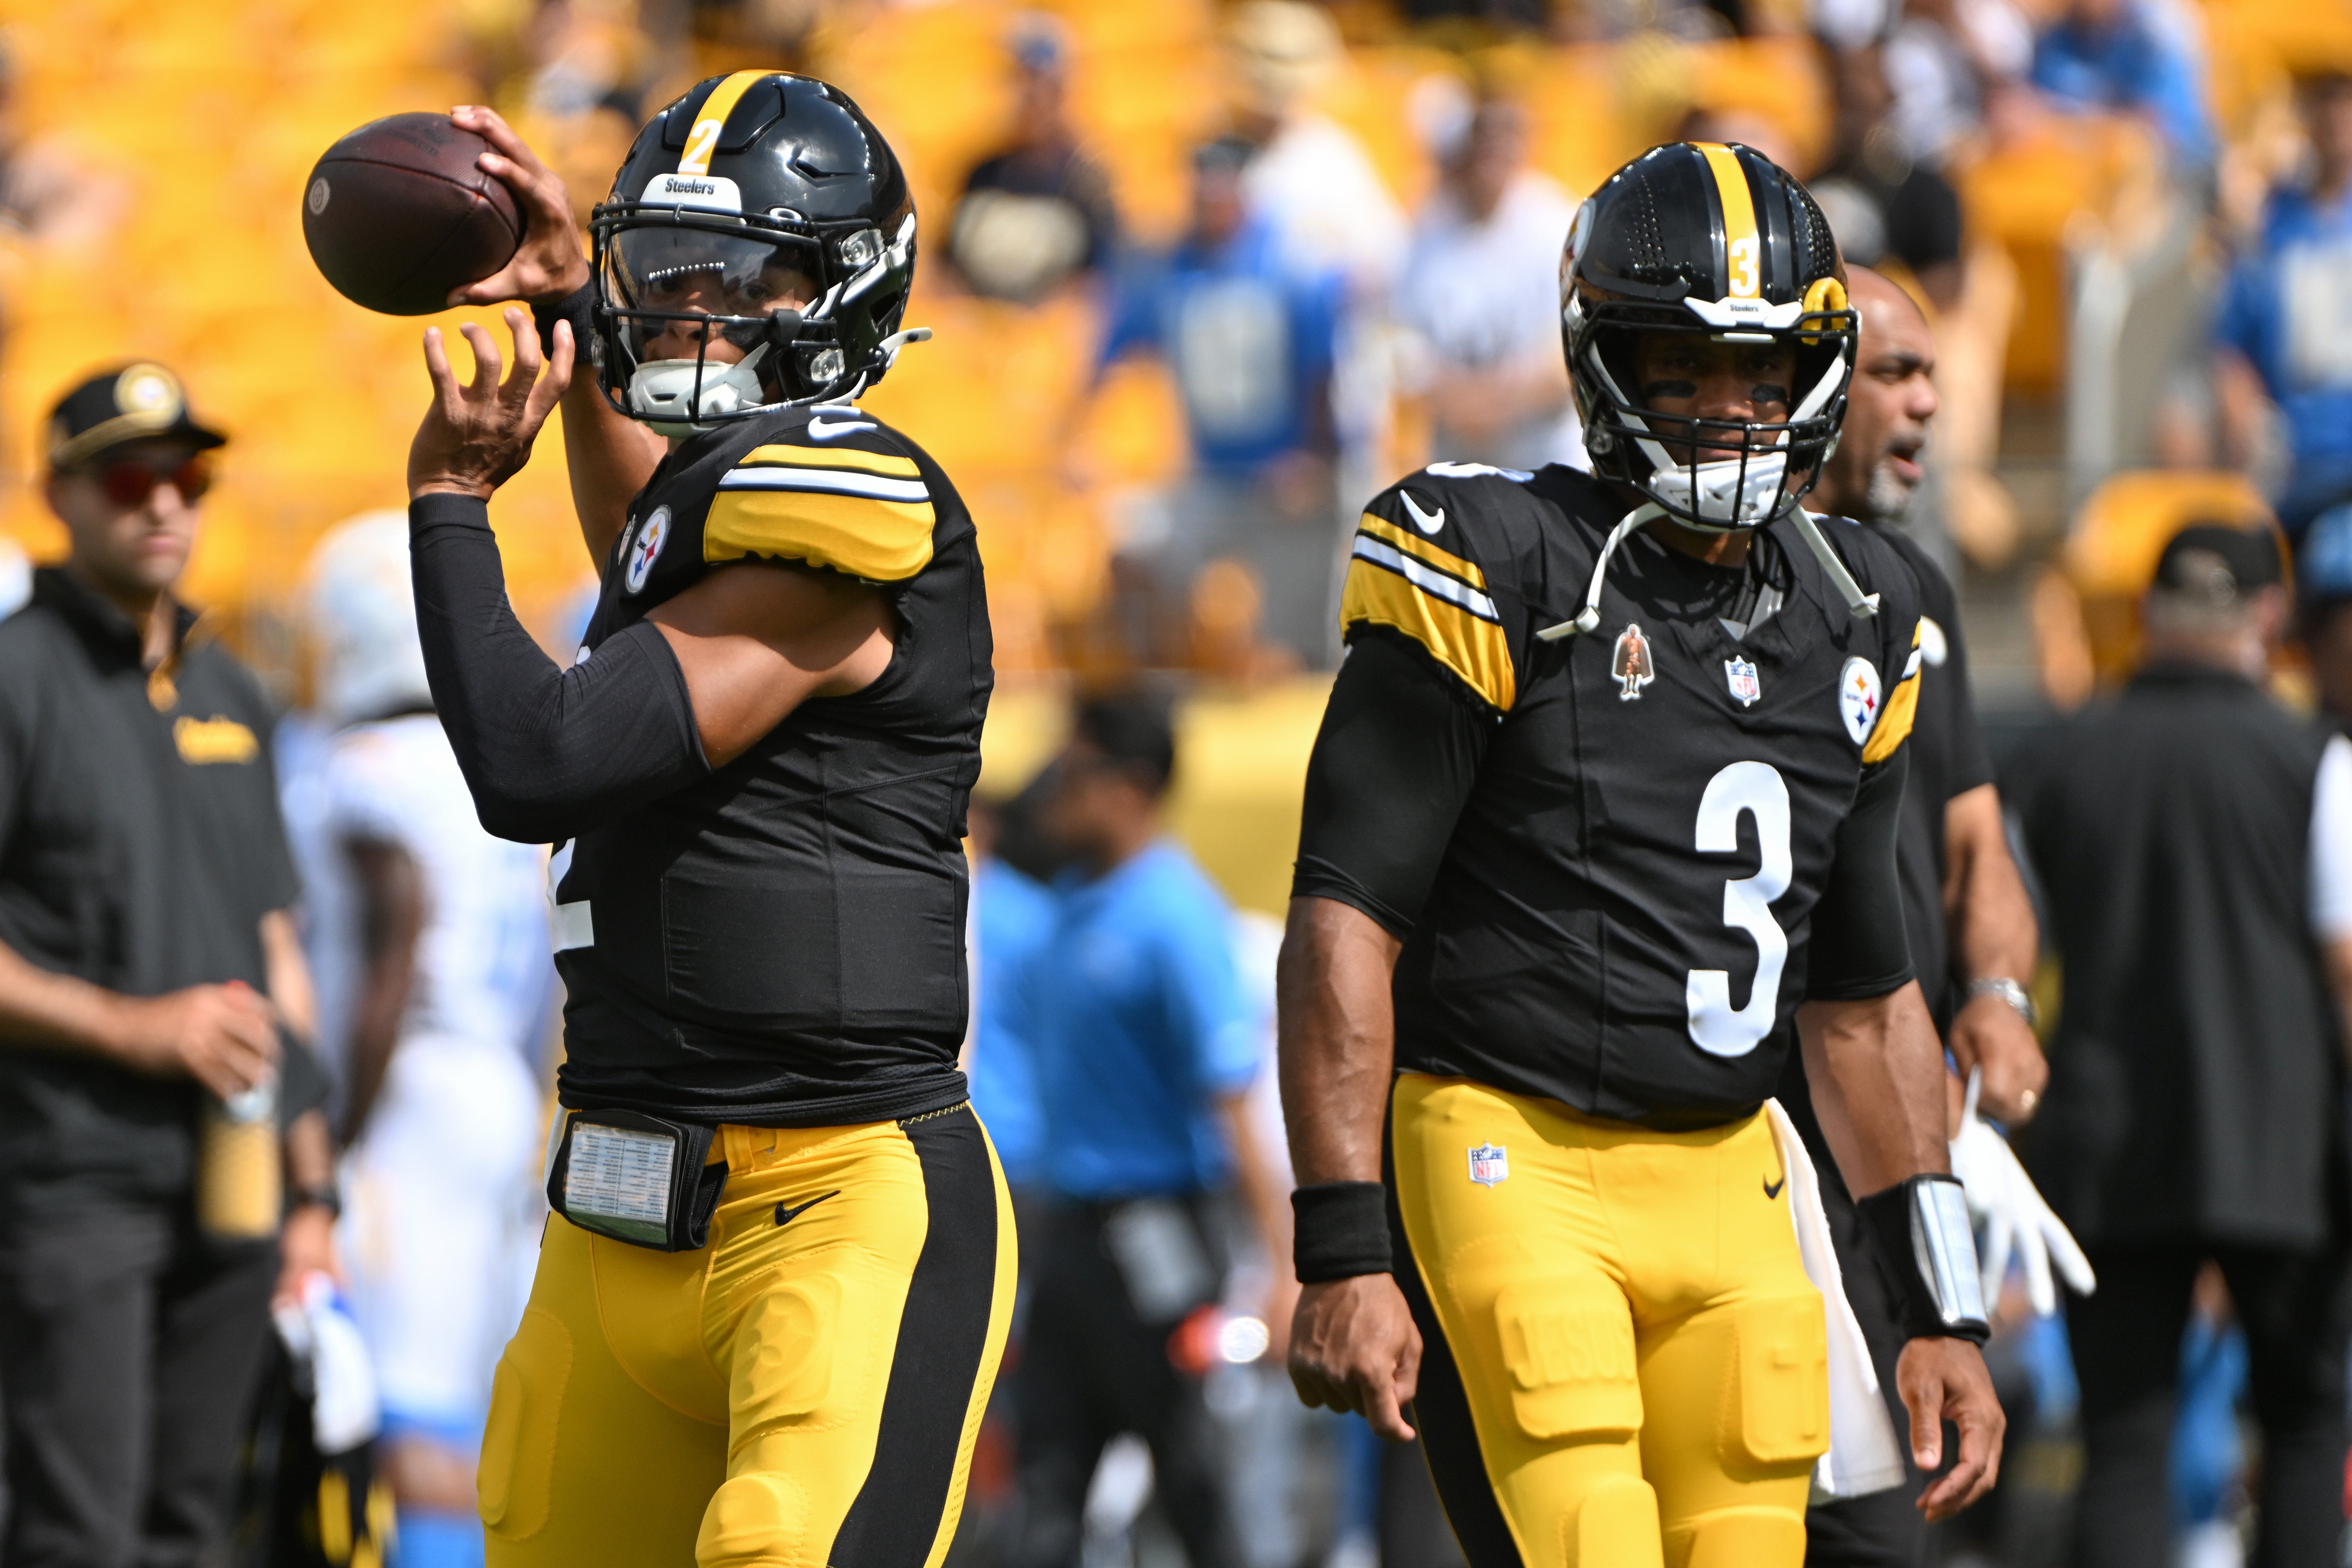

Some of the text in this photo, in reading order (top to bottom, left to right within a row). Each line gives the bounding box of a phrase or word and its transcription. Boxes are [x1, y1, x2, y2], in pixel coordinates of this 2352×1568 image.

[677, 119, 722, 173] 2
[665, 177, 715, 195] Steelers
[1730, 238, 1759, 296] 3
[1730, 303, 1759, 312] Steelers
[1686, 760, 1792, 1057] 3
[1476, 1161, 1501, 1179] NFL
[1513, 1311, 1635, 1388] JESUS
